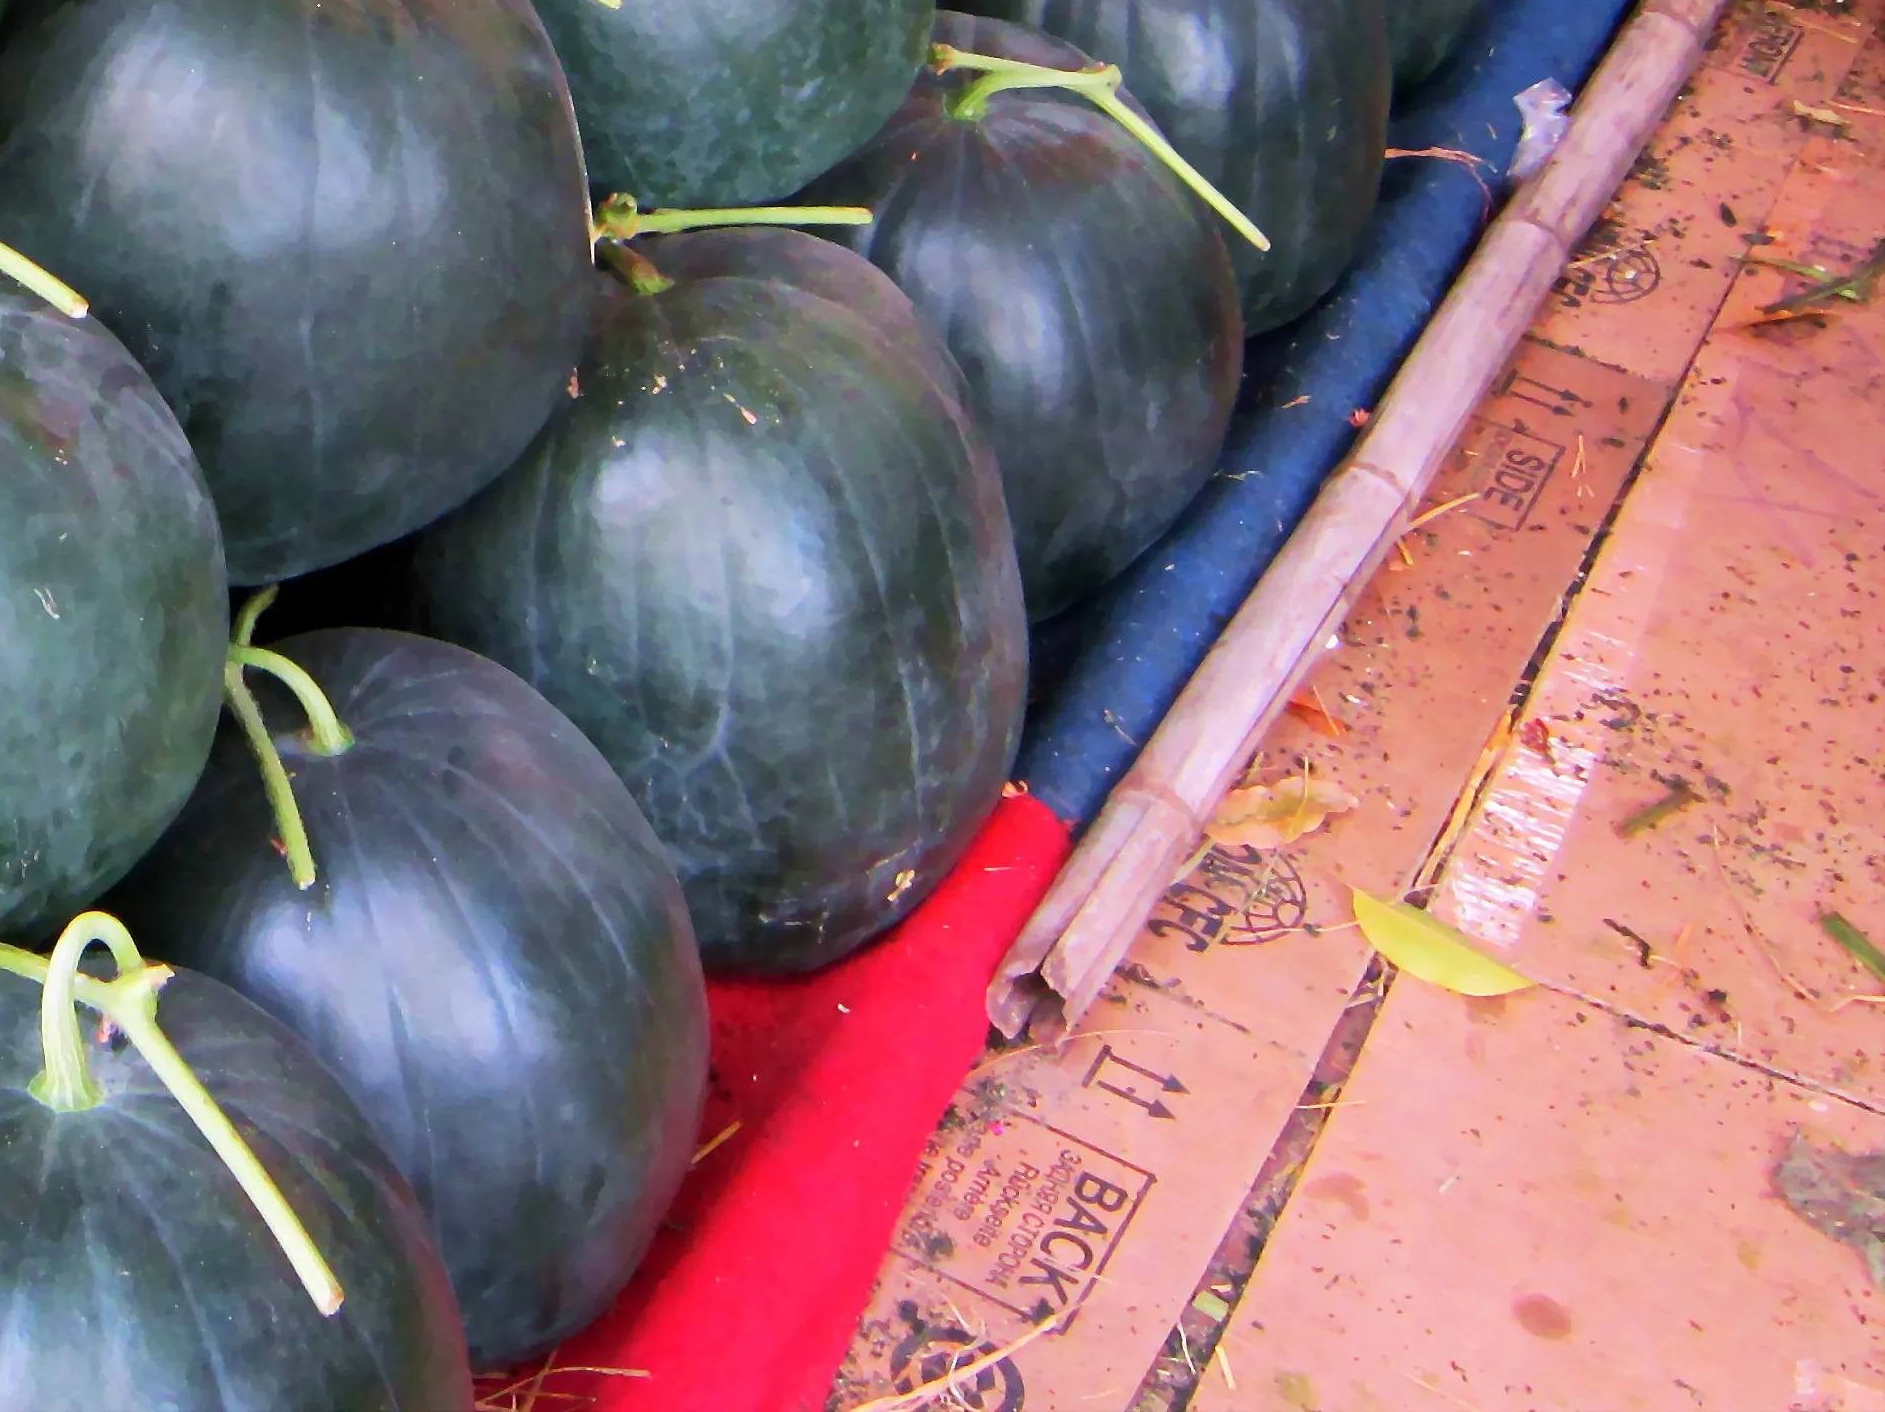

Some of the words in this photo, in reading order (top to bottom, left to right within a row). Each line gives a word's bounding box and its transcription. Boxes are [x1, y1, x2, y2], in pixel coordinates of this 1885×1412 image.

[1483, 446, 1544, 515] SIDE
[985, 1211, 1044, 1290] СТОРОНА
[1019, 1170, 1129, 1306] BACK
